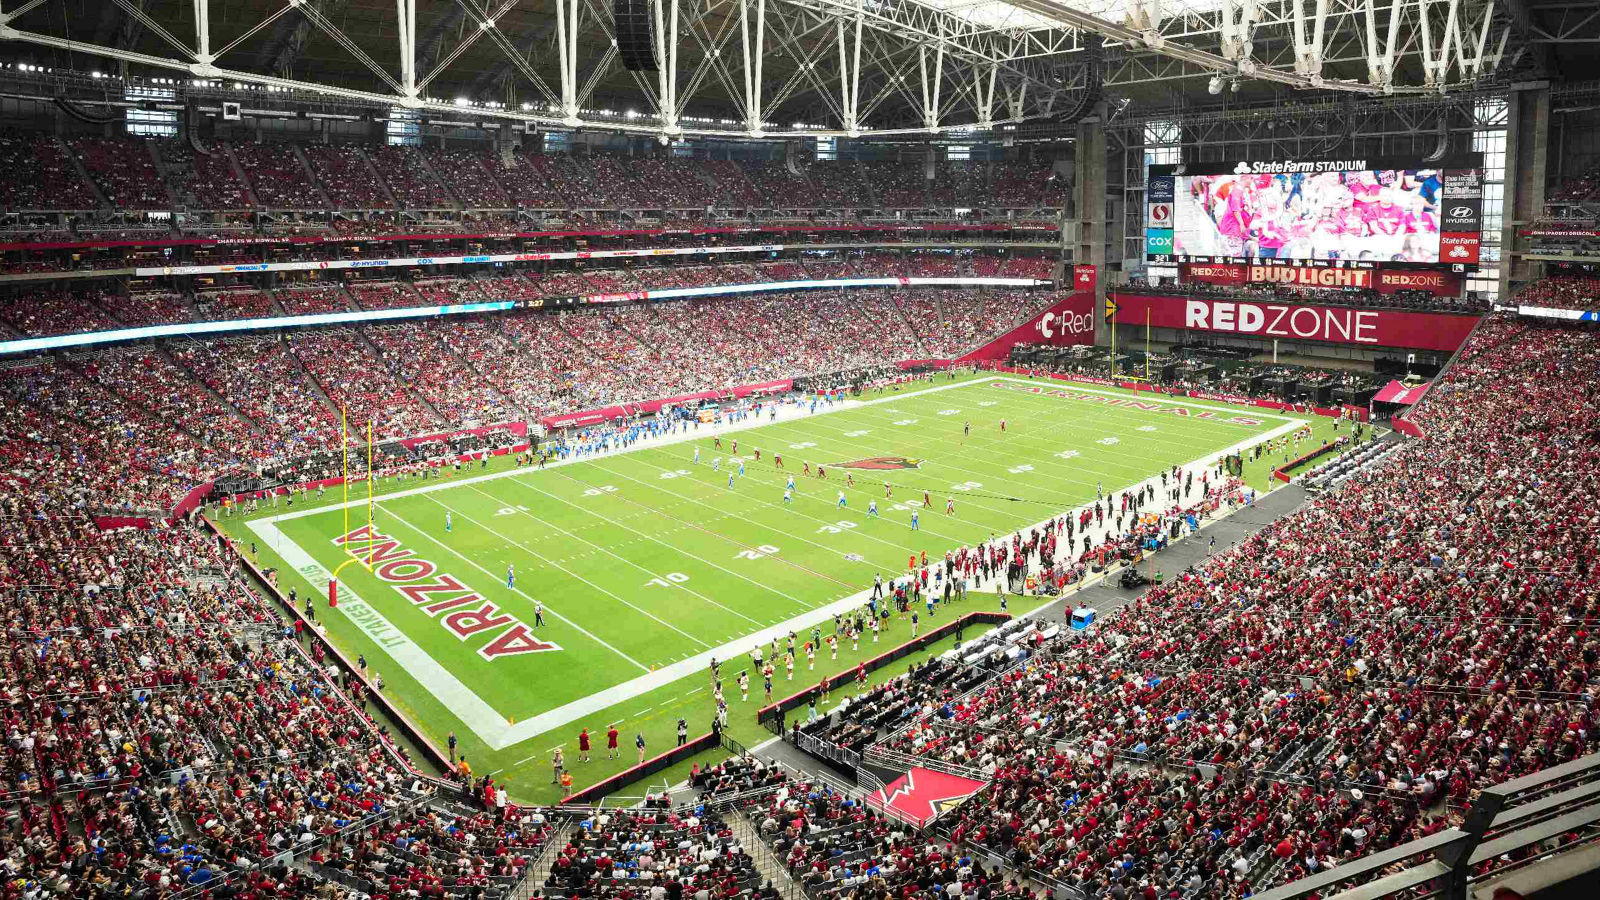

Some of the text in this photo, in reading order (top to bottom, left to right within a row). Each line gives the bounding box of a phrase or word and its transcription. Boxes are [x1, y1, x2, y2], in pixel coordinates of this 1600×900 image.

[1315, 160, 1366, 172] STADIUM
[1149, 237, 1172, 246] COX
[1190, 267, 1239, 278] REDZONE
[1251, 266, 1367, 286] BUD LIGHT
[1382, 274, 1445, 287] REDZONE
[1185, 300, 1379, 343] REDZONE
[818, 520, 858, 534] 30
[737, 544, 781, 561] 20
[648, 572, 690, 588] 10
[329, 522, 565, 662] ARIZONA
